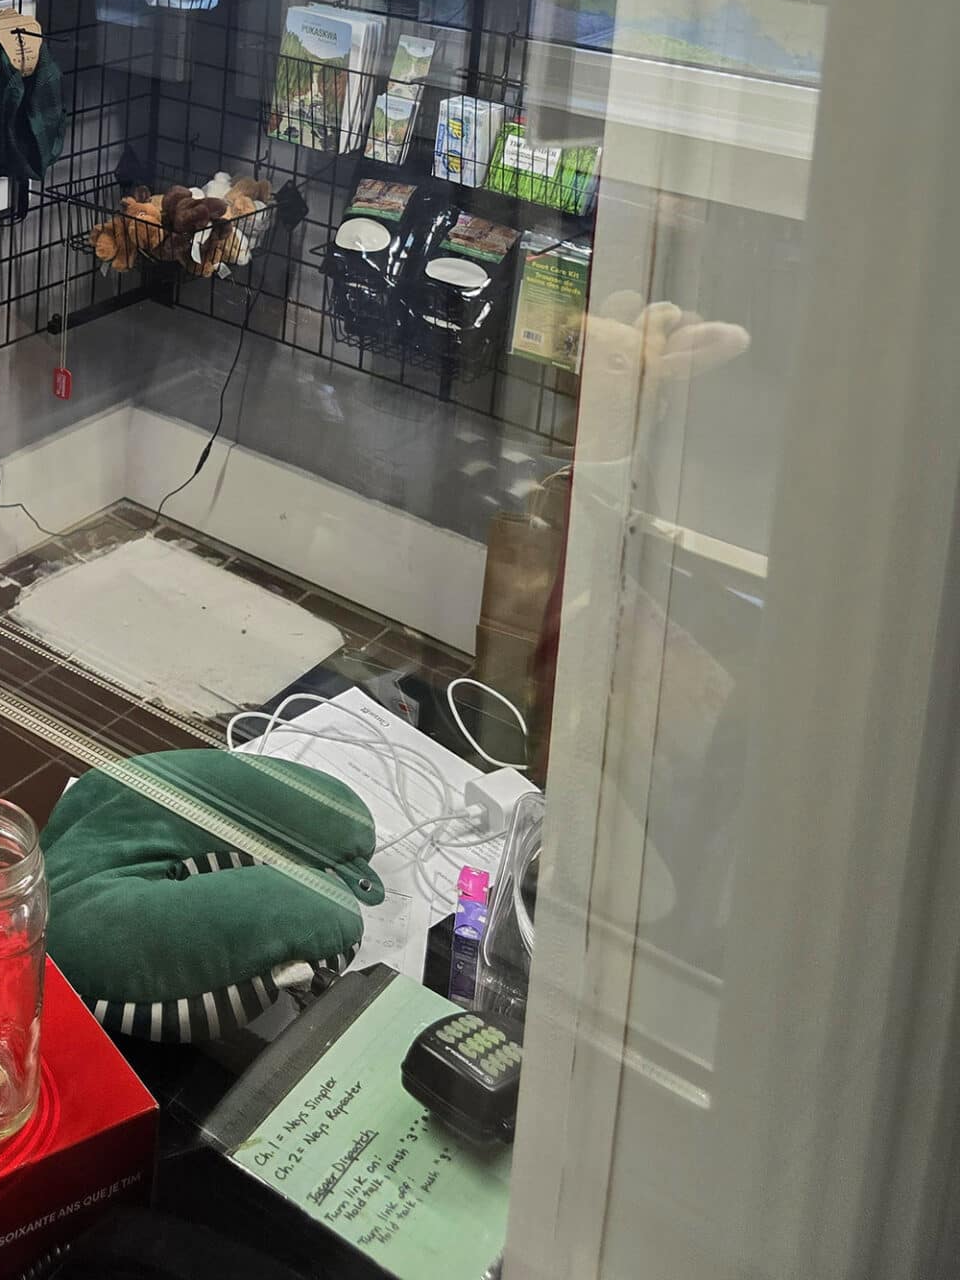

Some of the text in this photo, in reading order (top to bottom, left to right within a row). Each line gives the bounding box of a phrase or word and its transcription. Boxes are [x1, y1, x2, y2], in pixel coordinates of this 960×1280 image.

[304, 1076, 337, 1110] Simplex
[325, 1081, 361, 1120] Repeater
[331, 1129, 376, 1173] Dispatch
[57, 1201, 81, 1219] ANS
[83, 1188, 107, 1206] QUE
[107, 1182, 120, 1199] JE
[324, 1200, 350, 1222] Turn
[344, 1176, 368, 1199] link
[344, 1198, 367, 1221] Hold
[386, 1148, 409, 1173] push
